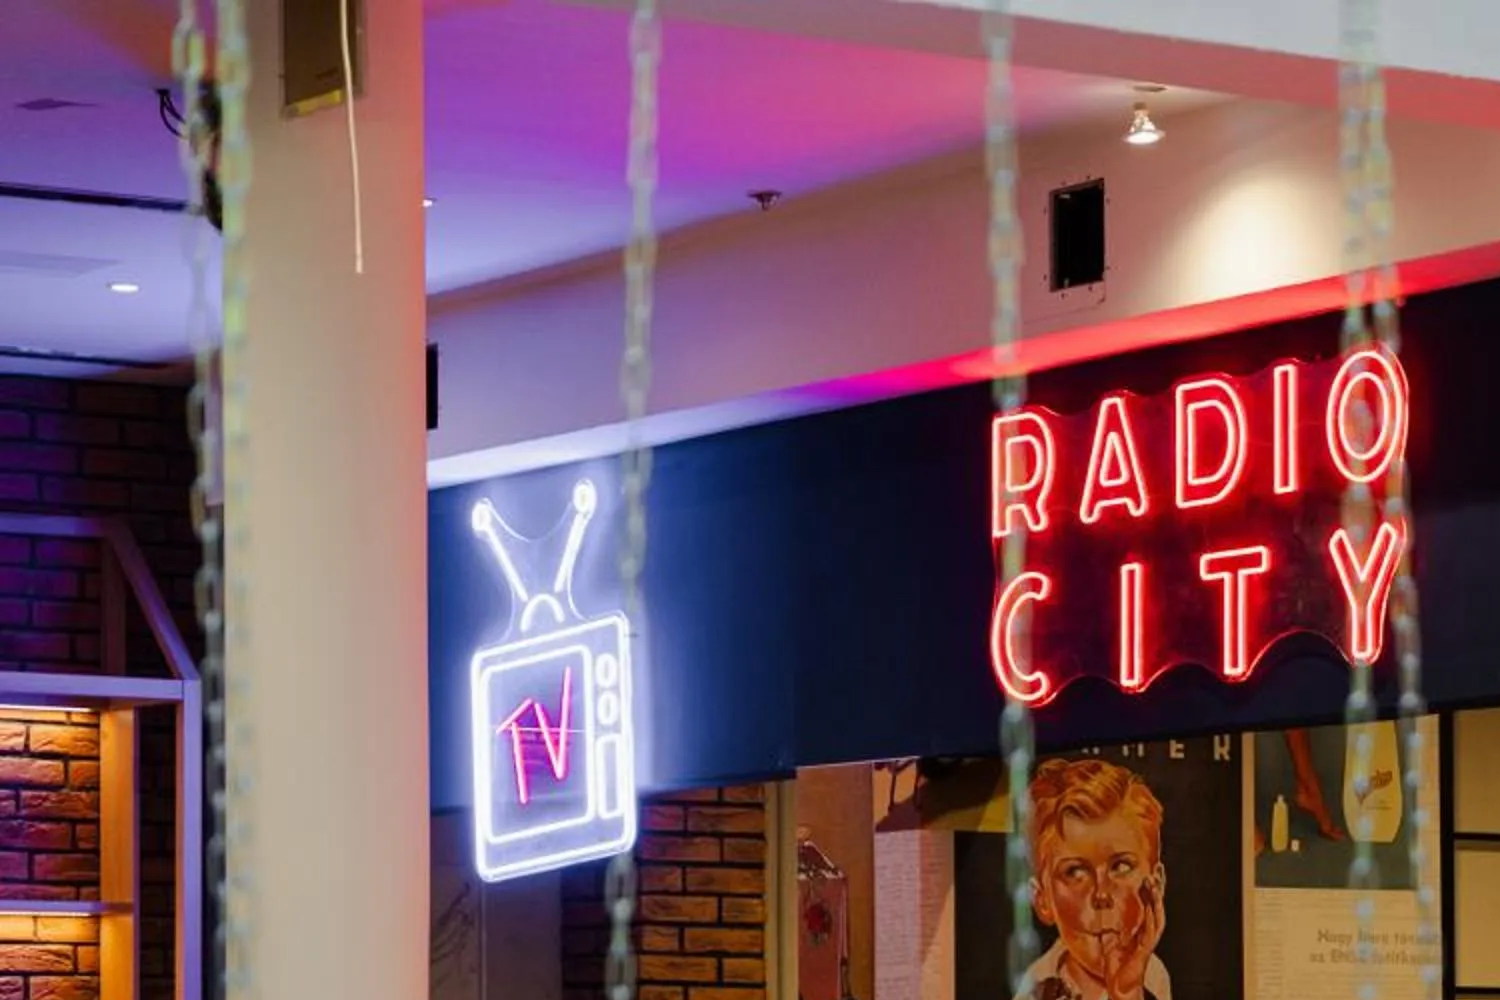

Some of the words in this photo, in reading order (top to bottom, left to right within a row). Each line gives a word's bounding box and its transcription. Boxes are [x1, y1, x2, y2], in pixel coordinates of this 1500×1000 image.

[991, 349, 1408, 537] RADIO
[991, 522, 1403, 702] CITY
[496, 665, 572, 805] TV
